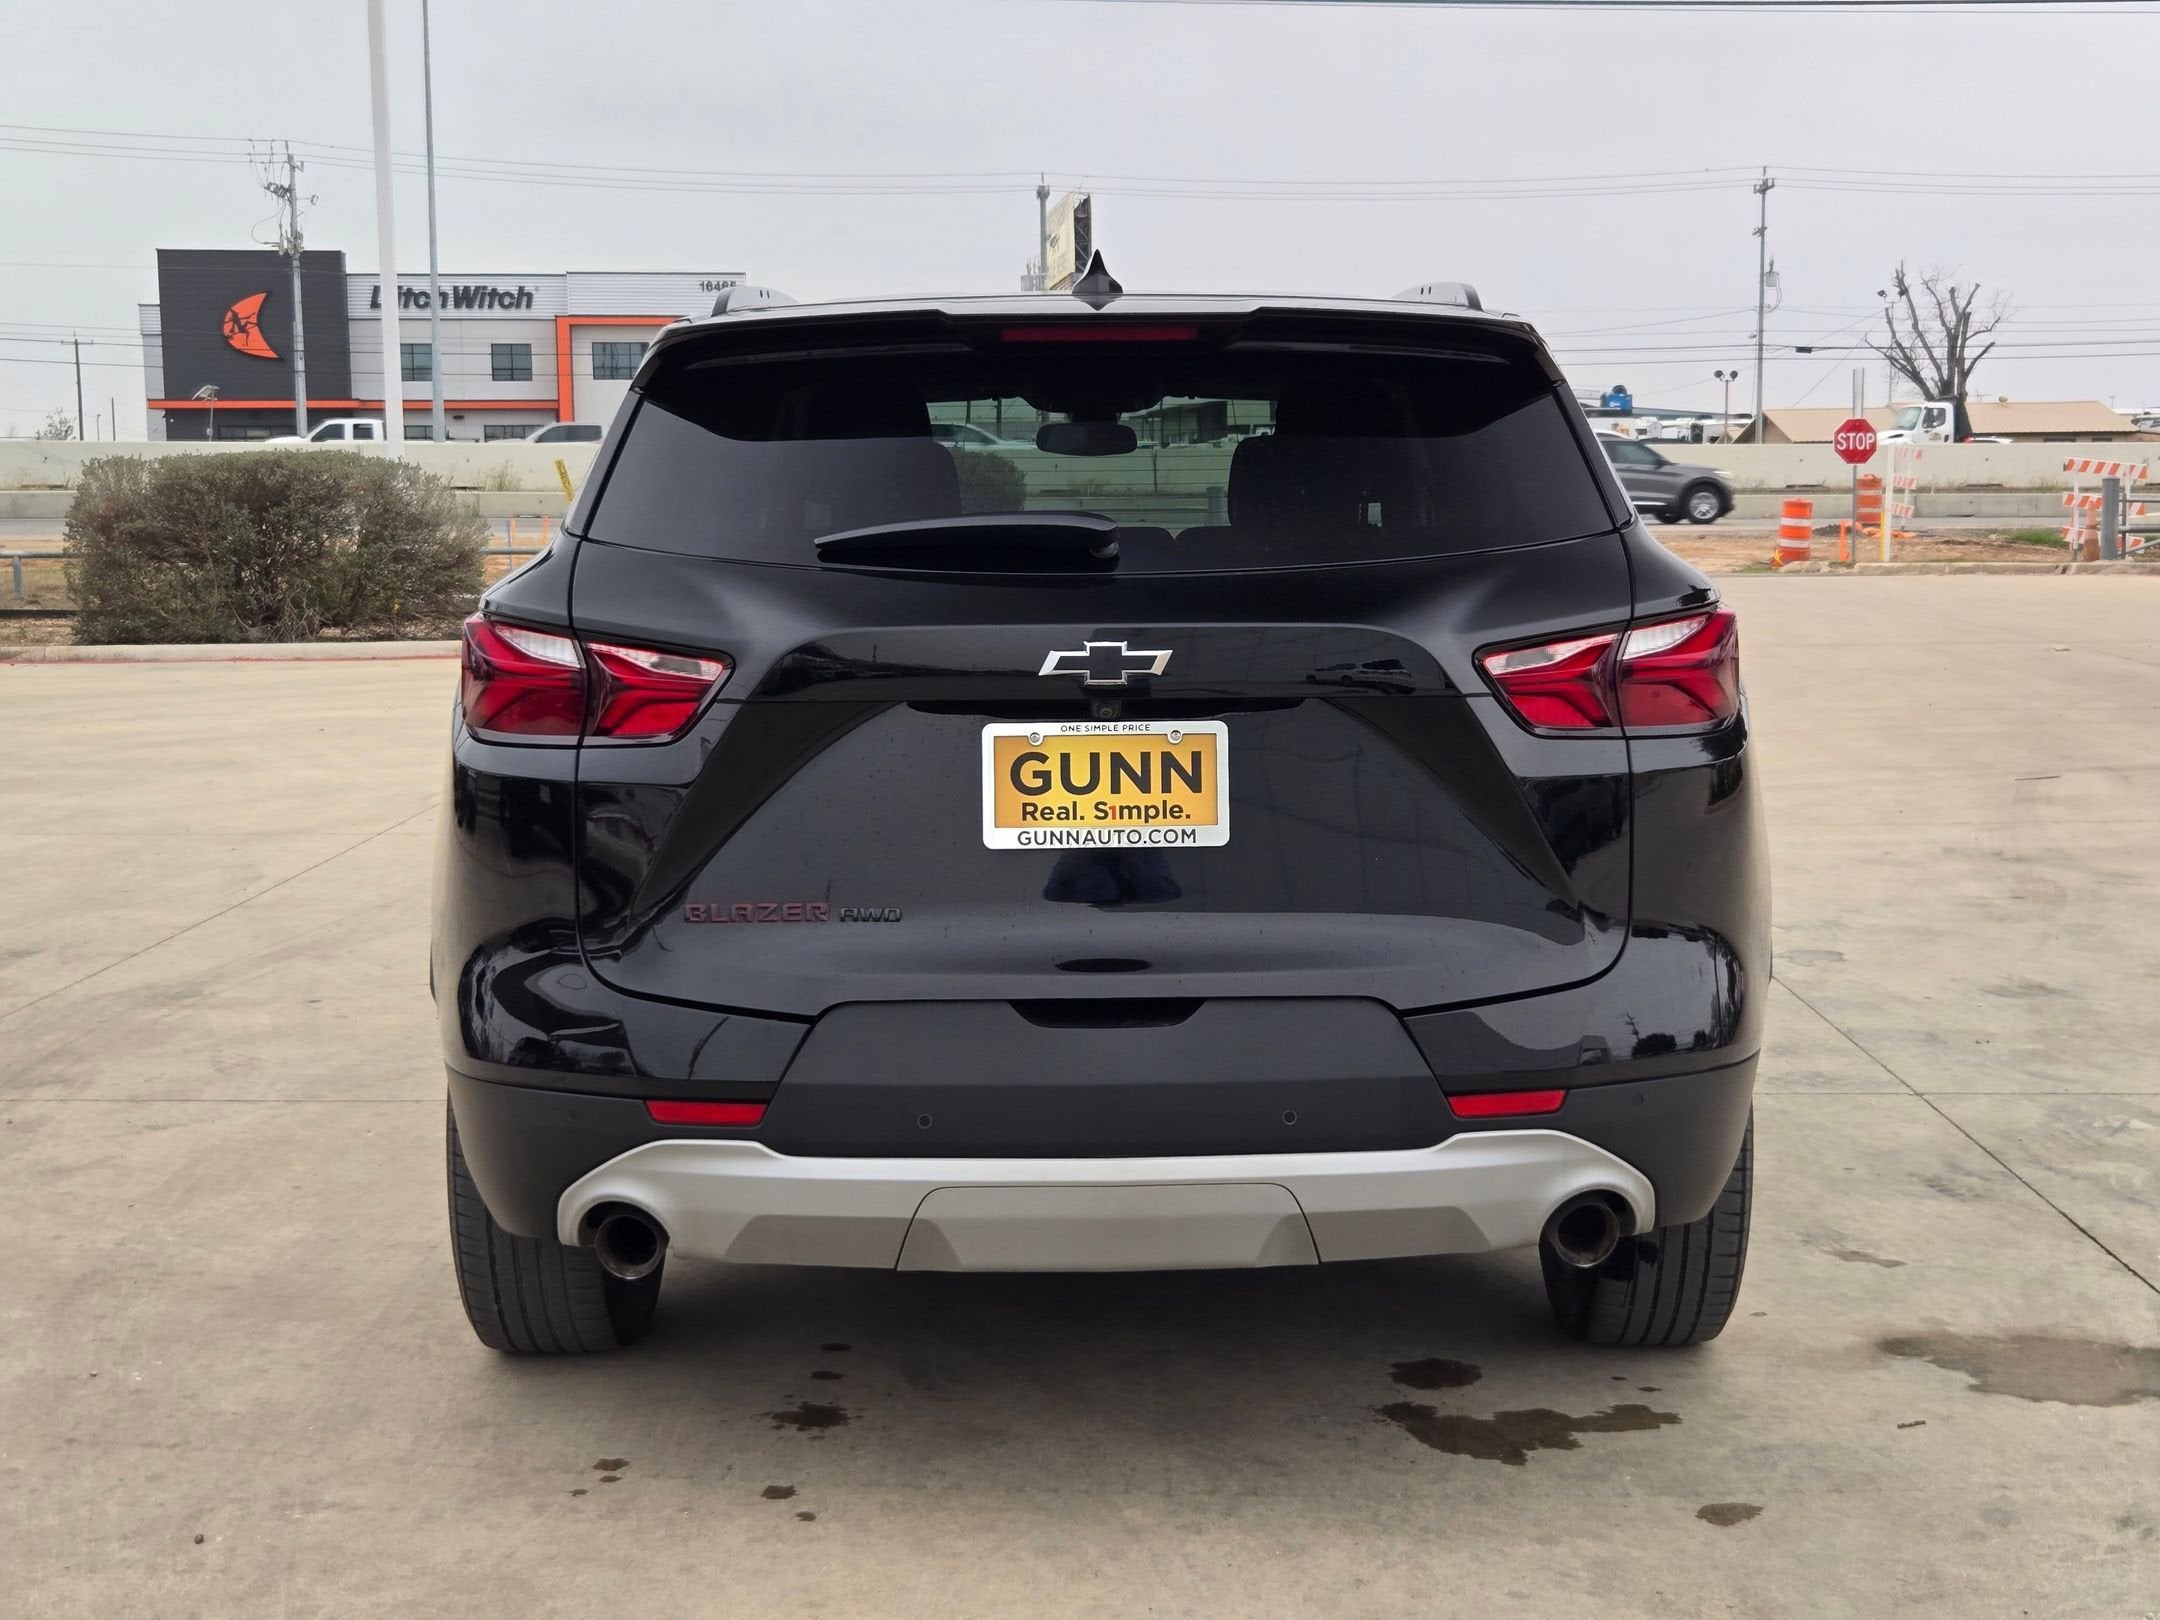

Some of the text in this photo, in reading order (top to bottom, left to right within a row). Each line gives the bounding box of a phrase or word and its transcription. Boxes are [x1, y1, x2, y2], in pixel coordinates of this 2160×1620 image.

[453, 285, 534, 309] Witch
[1836, 432, 1875, 450] STOP
[1061, 723, 1151, 733] ONE SIMPLE PRICE
[1010, 751, 1202, 796] GUNN
[1021, 801, 1085, 821] Real.
[1017, 829, 1197, 846] GUNNAUTO.COM
[685, 902, 901, 923] BLAZER AWD
